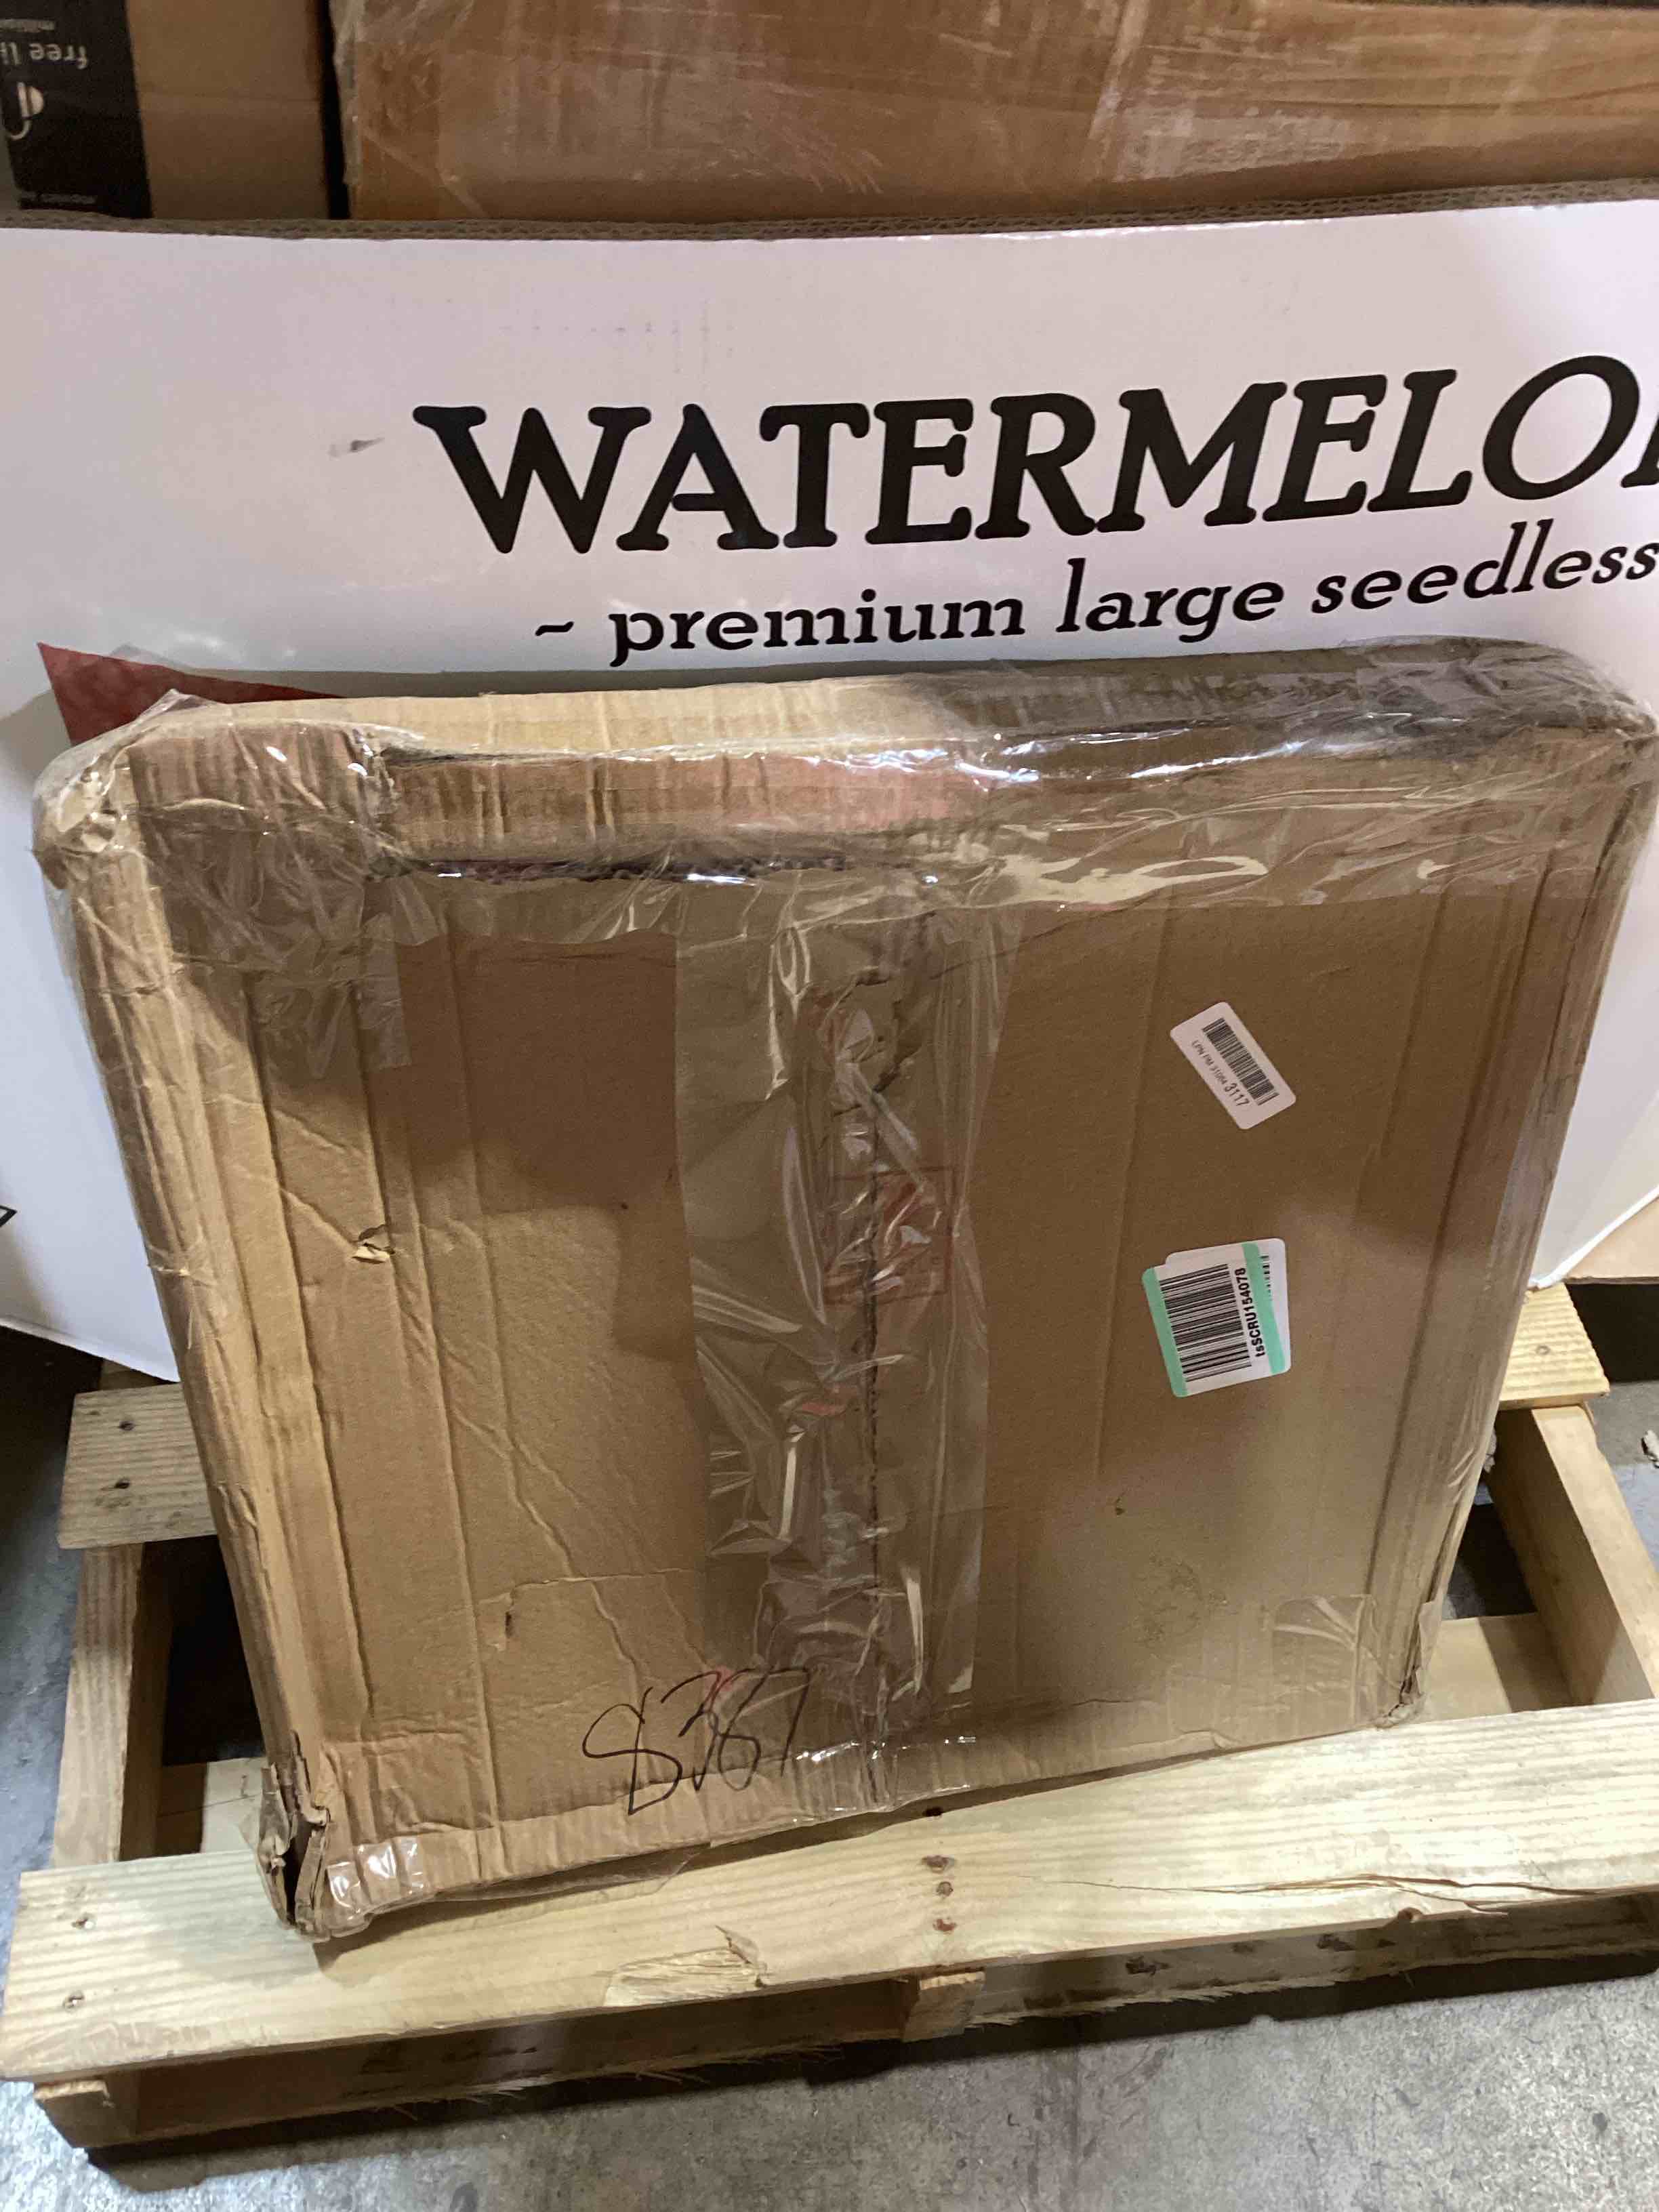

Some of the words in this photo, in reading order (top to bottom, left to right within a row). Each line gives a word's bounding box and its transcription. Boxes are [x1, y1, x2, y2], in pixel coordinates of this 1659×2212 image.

[29, 43, 88, 69] free
[609, 589, 1025, 667] premium
[1056, 558, 1284, 645] large
[1312, 519, 1659, 613] seedless
[1224, 1083, 1250, 1106] 3117
[1234, 1267, 1266, 1357] tsSCRU154078
